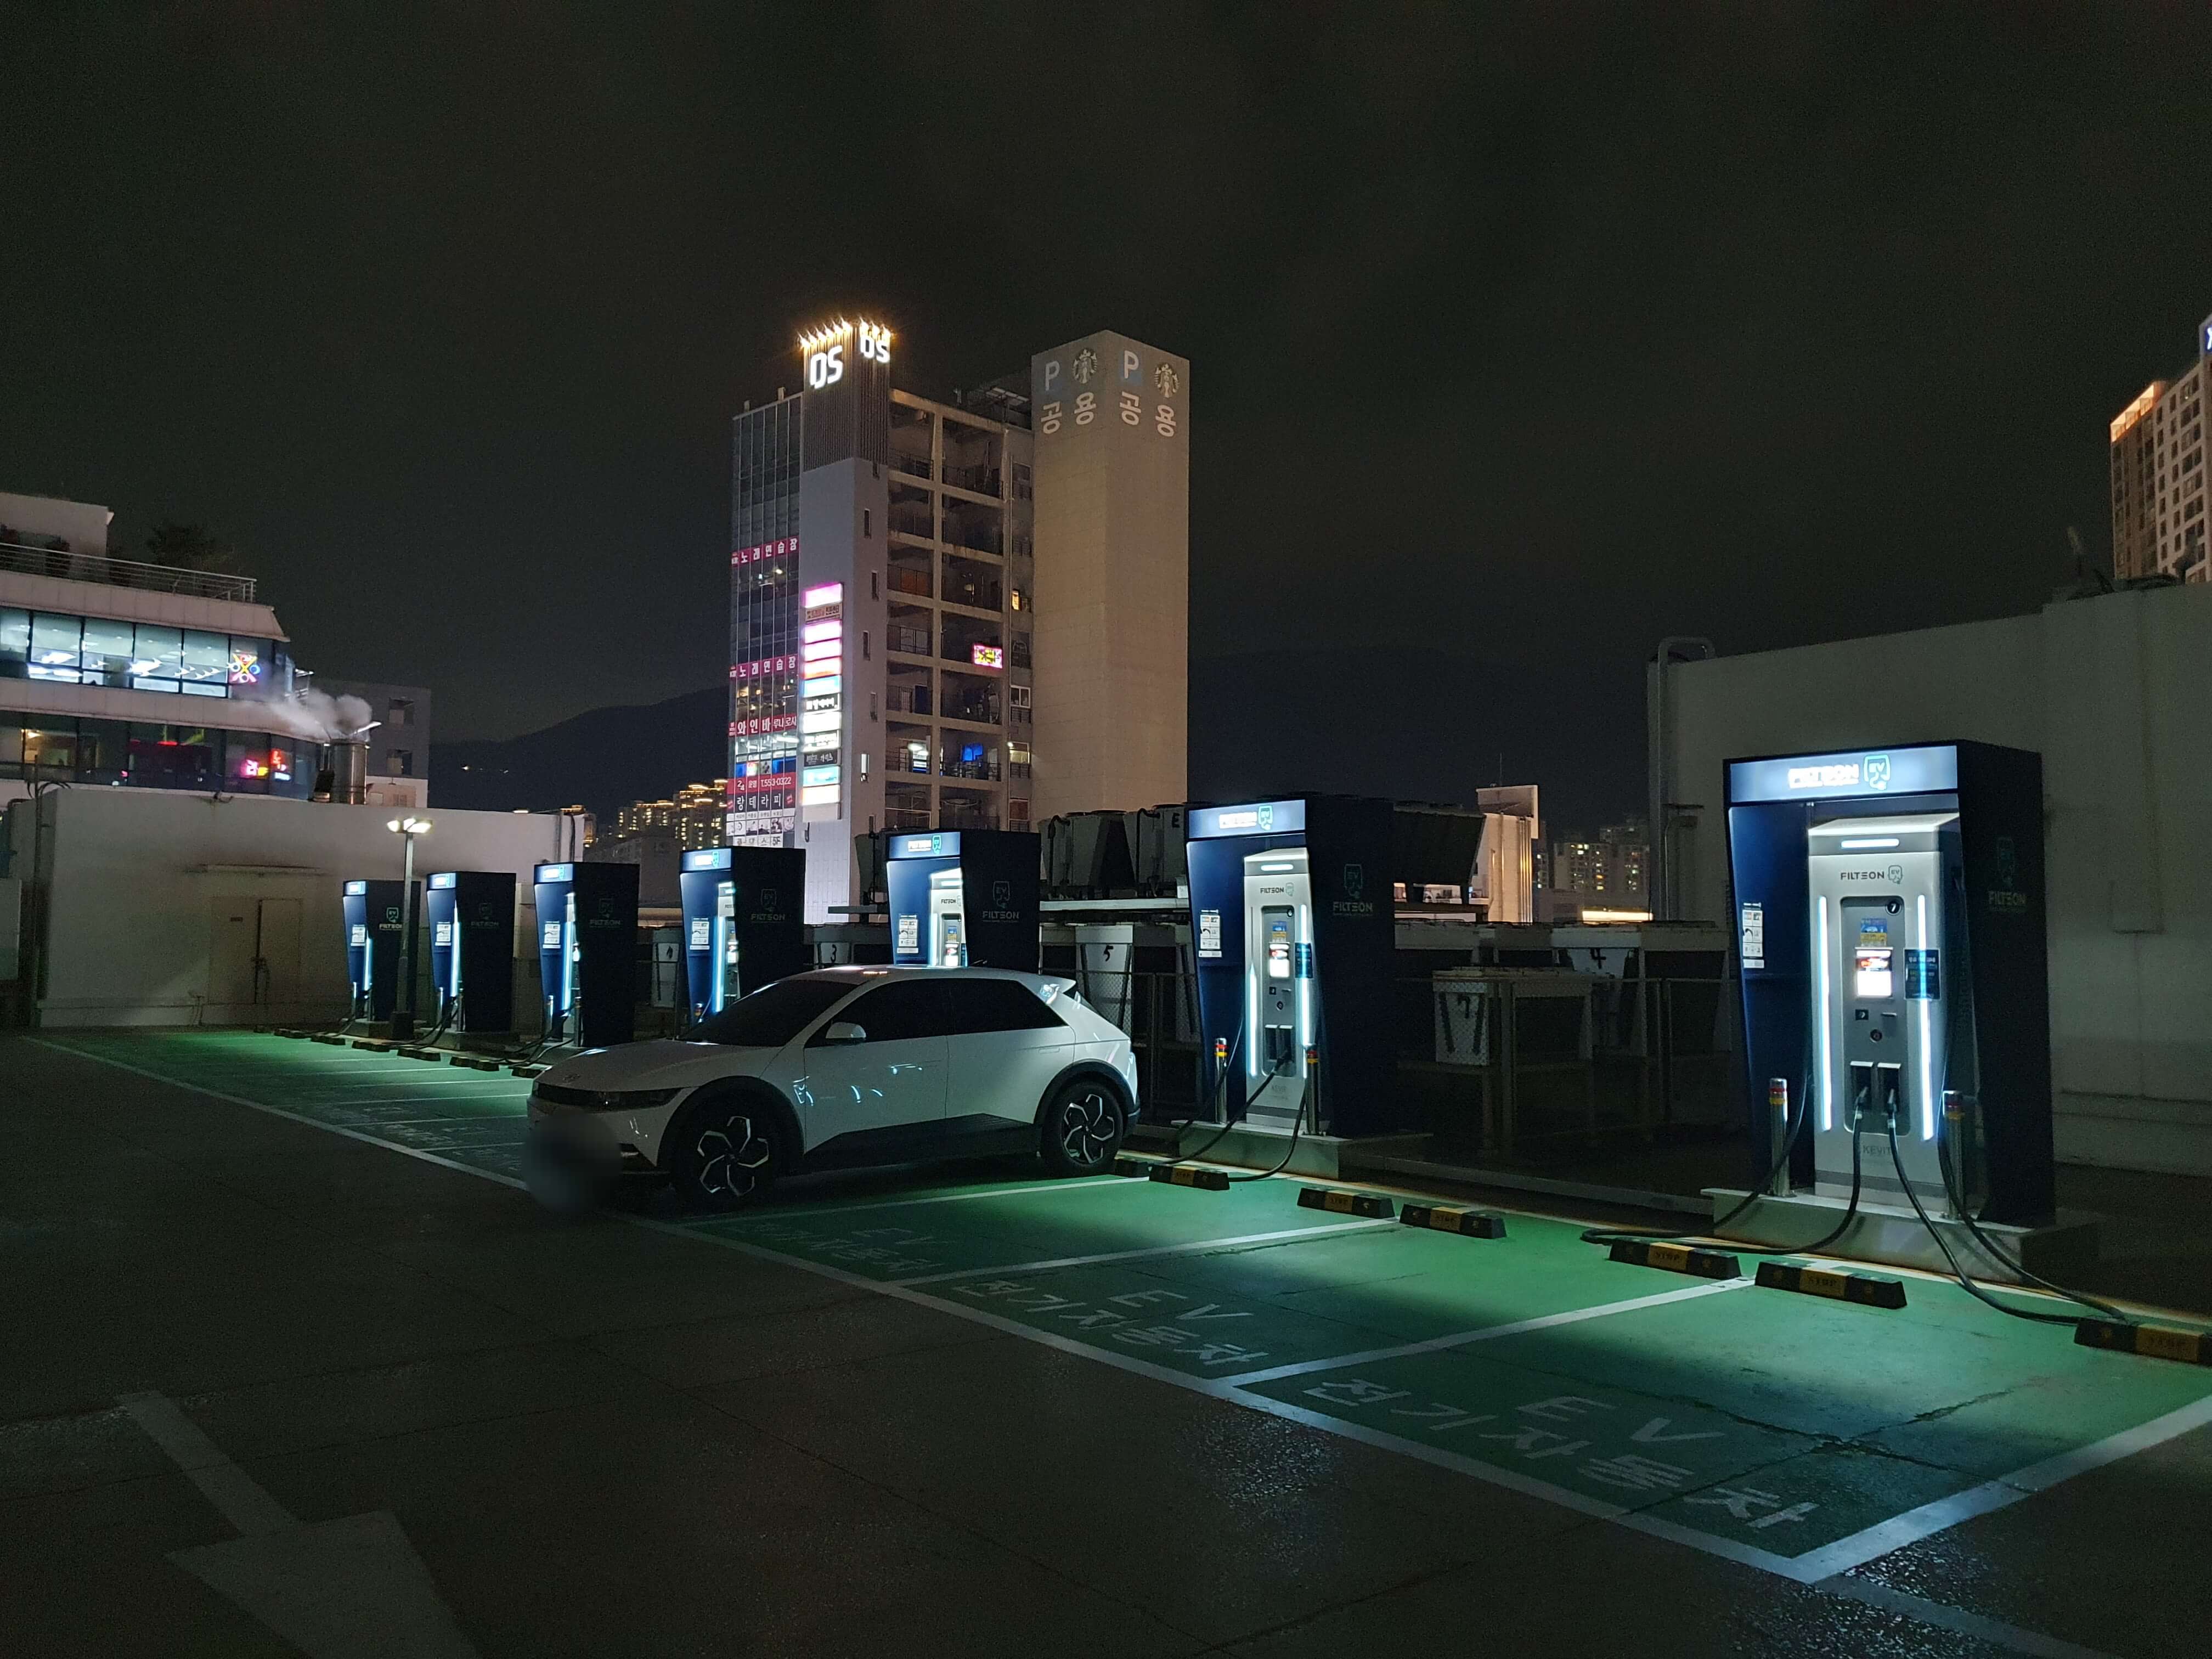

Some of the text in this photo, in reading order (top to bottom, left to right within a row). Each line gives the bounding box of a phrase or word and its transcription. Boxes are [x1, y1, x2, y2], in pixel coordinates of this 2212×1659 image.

[1124, 349, 1139, 379] P
[1045, 360, 1060, 391] P
[737, 717, 771, 735] 와인바
[1172, 812, 1180, 828] E
[1840, 871, 1885, 881] FILTEON
[1333, 901, 1373, 912] FILTEON
[1891, 903, 1897, 912] 7
[983, 911, 1019, 919] FILTEON
[1104, 945, 1113, 961] 5
[1516, 1395, 1726, 1443] EV
